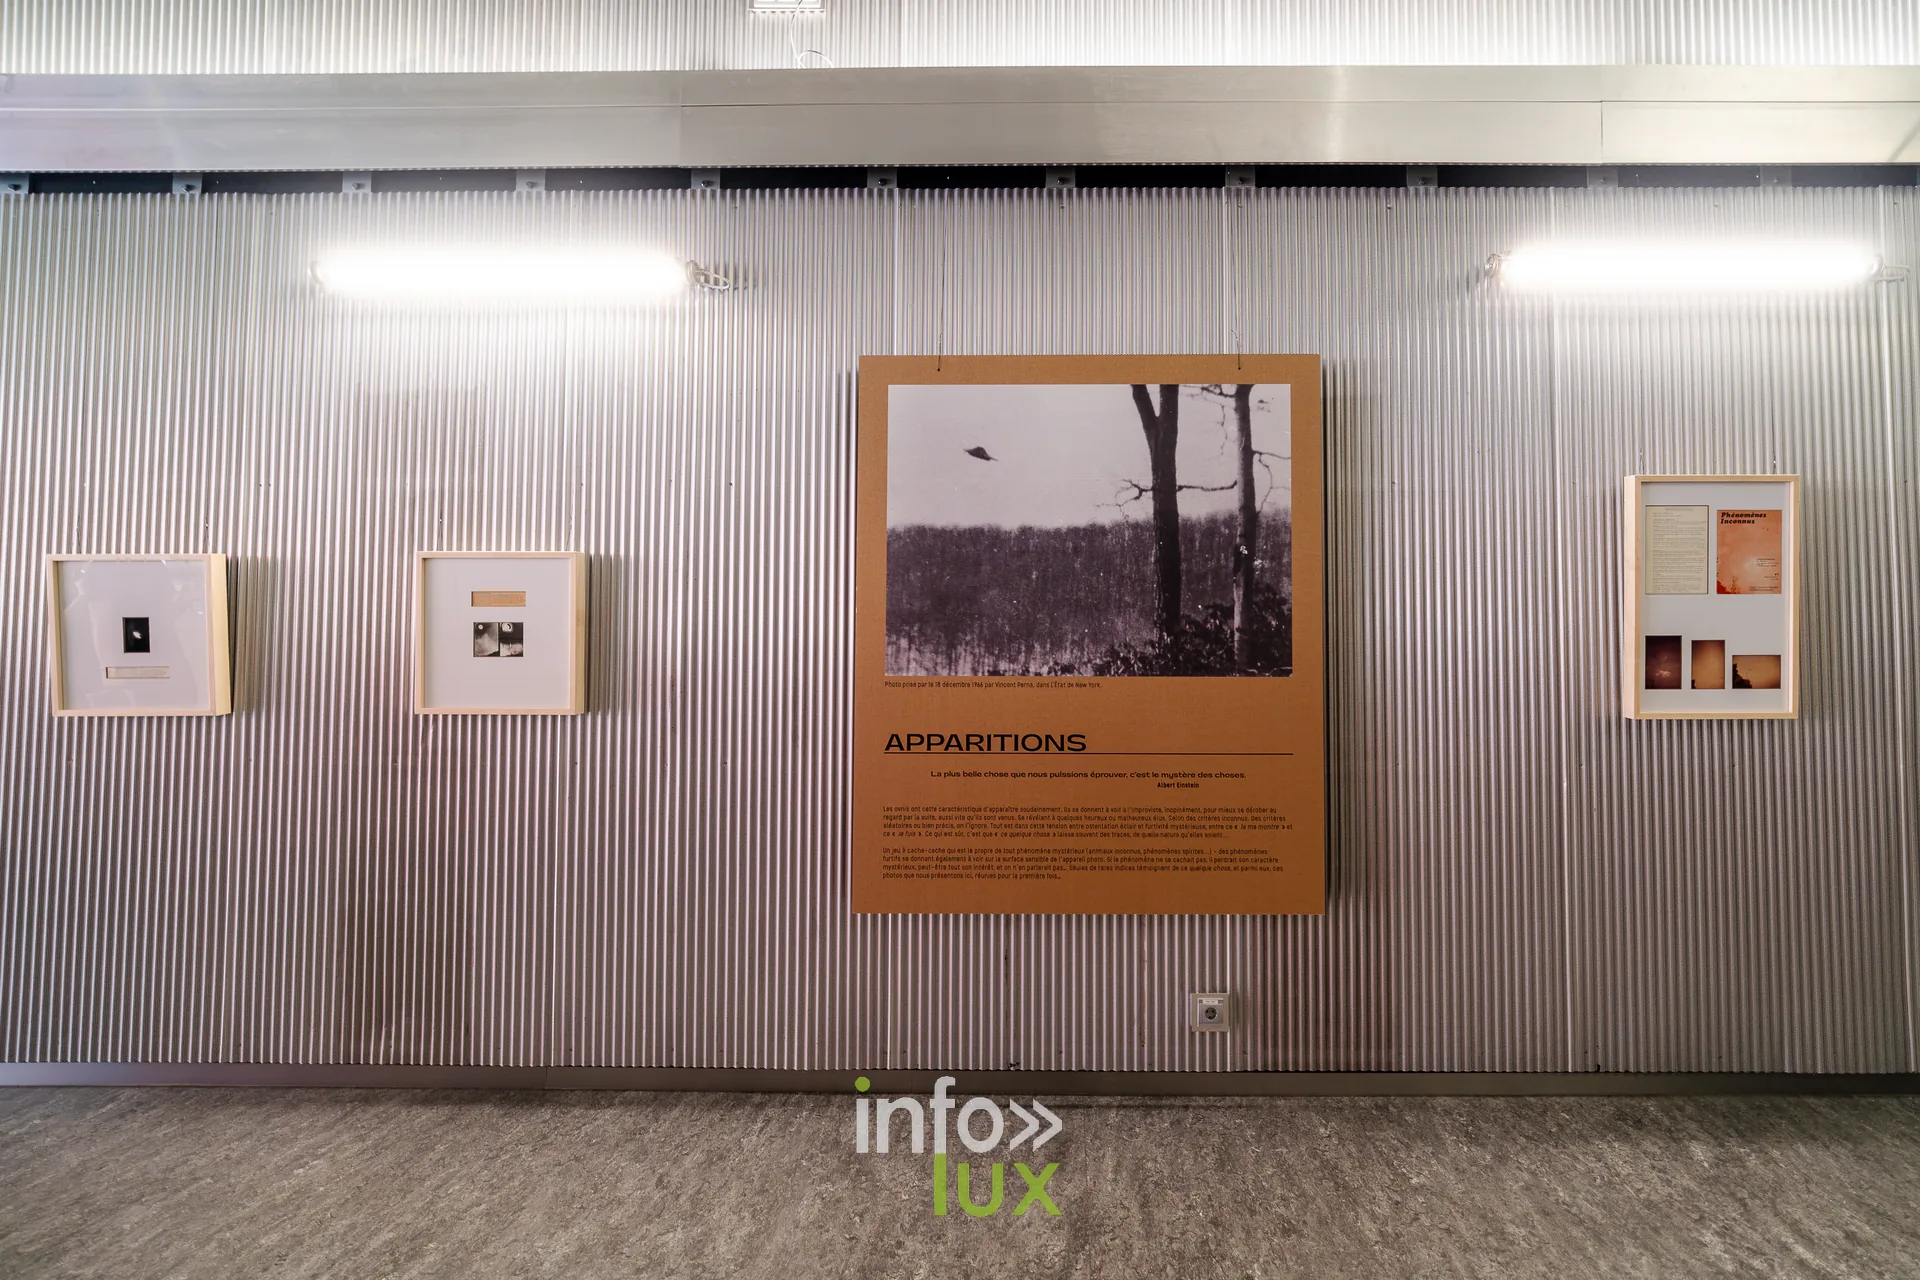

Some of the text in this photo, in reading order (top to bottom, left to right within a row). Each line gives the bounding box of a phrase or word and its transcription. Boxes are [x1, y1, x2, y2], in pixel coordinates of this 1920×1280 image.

[903, 681, 917, 689] prise
[885, 733, 1087, 752] APPARITIONS
[944, 771, 961, 779] plus
[1049, 771, 1088, 779] puissions
[1161, 772, 1196, 780] mystère
